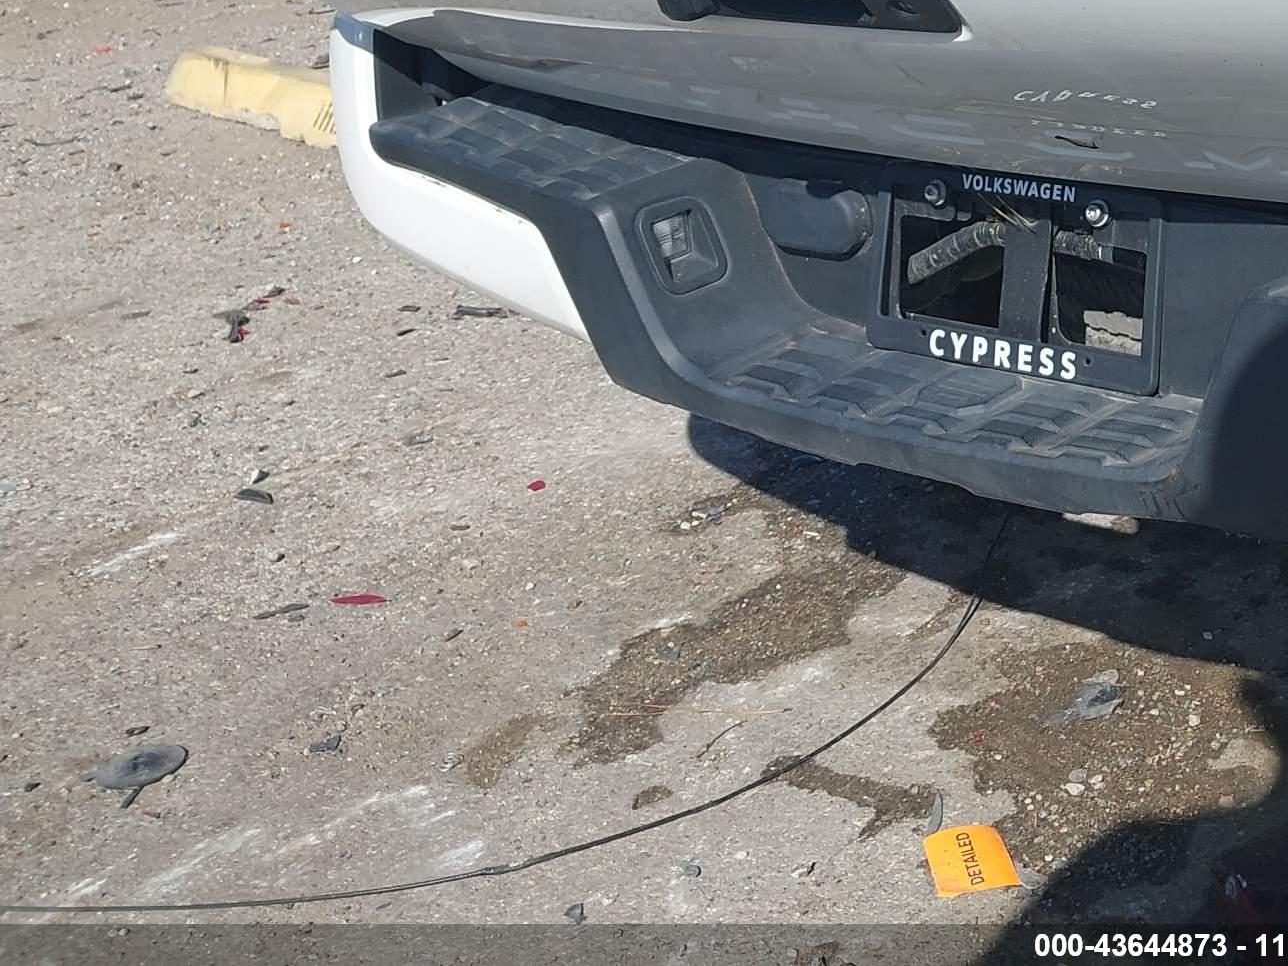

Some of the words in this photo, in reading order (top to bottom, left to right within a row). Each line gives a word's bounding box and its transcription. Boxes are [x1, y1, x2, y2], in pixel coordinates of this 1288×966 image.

[962, 173, 1076, 202] VOLKSWAGEN
[929, 328, 1077, 380] CYPRESS
[956, 832, 985, 886] DETAILED
